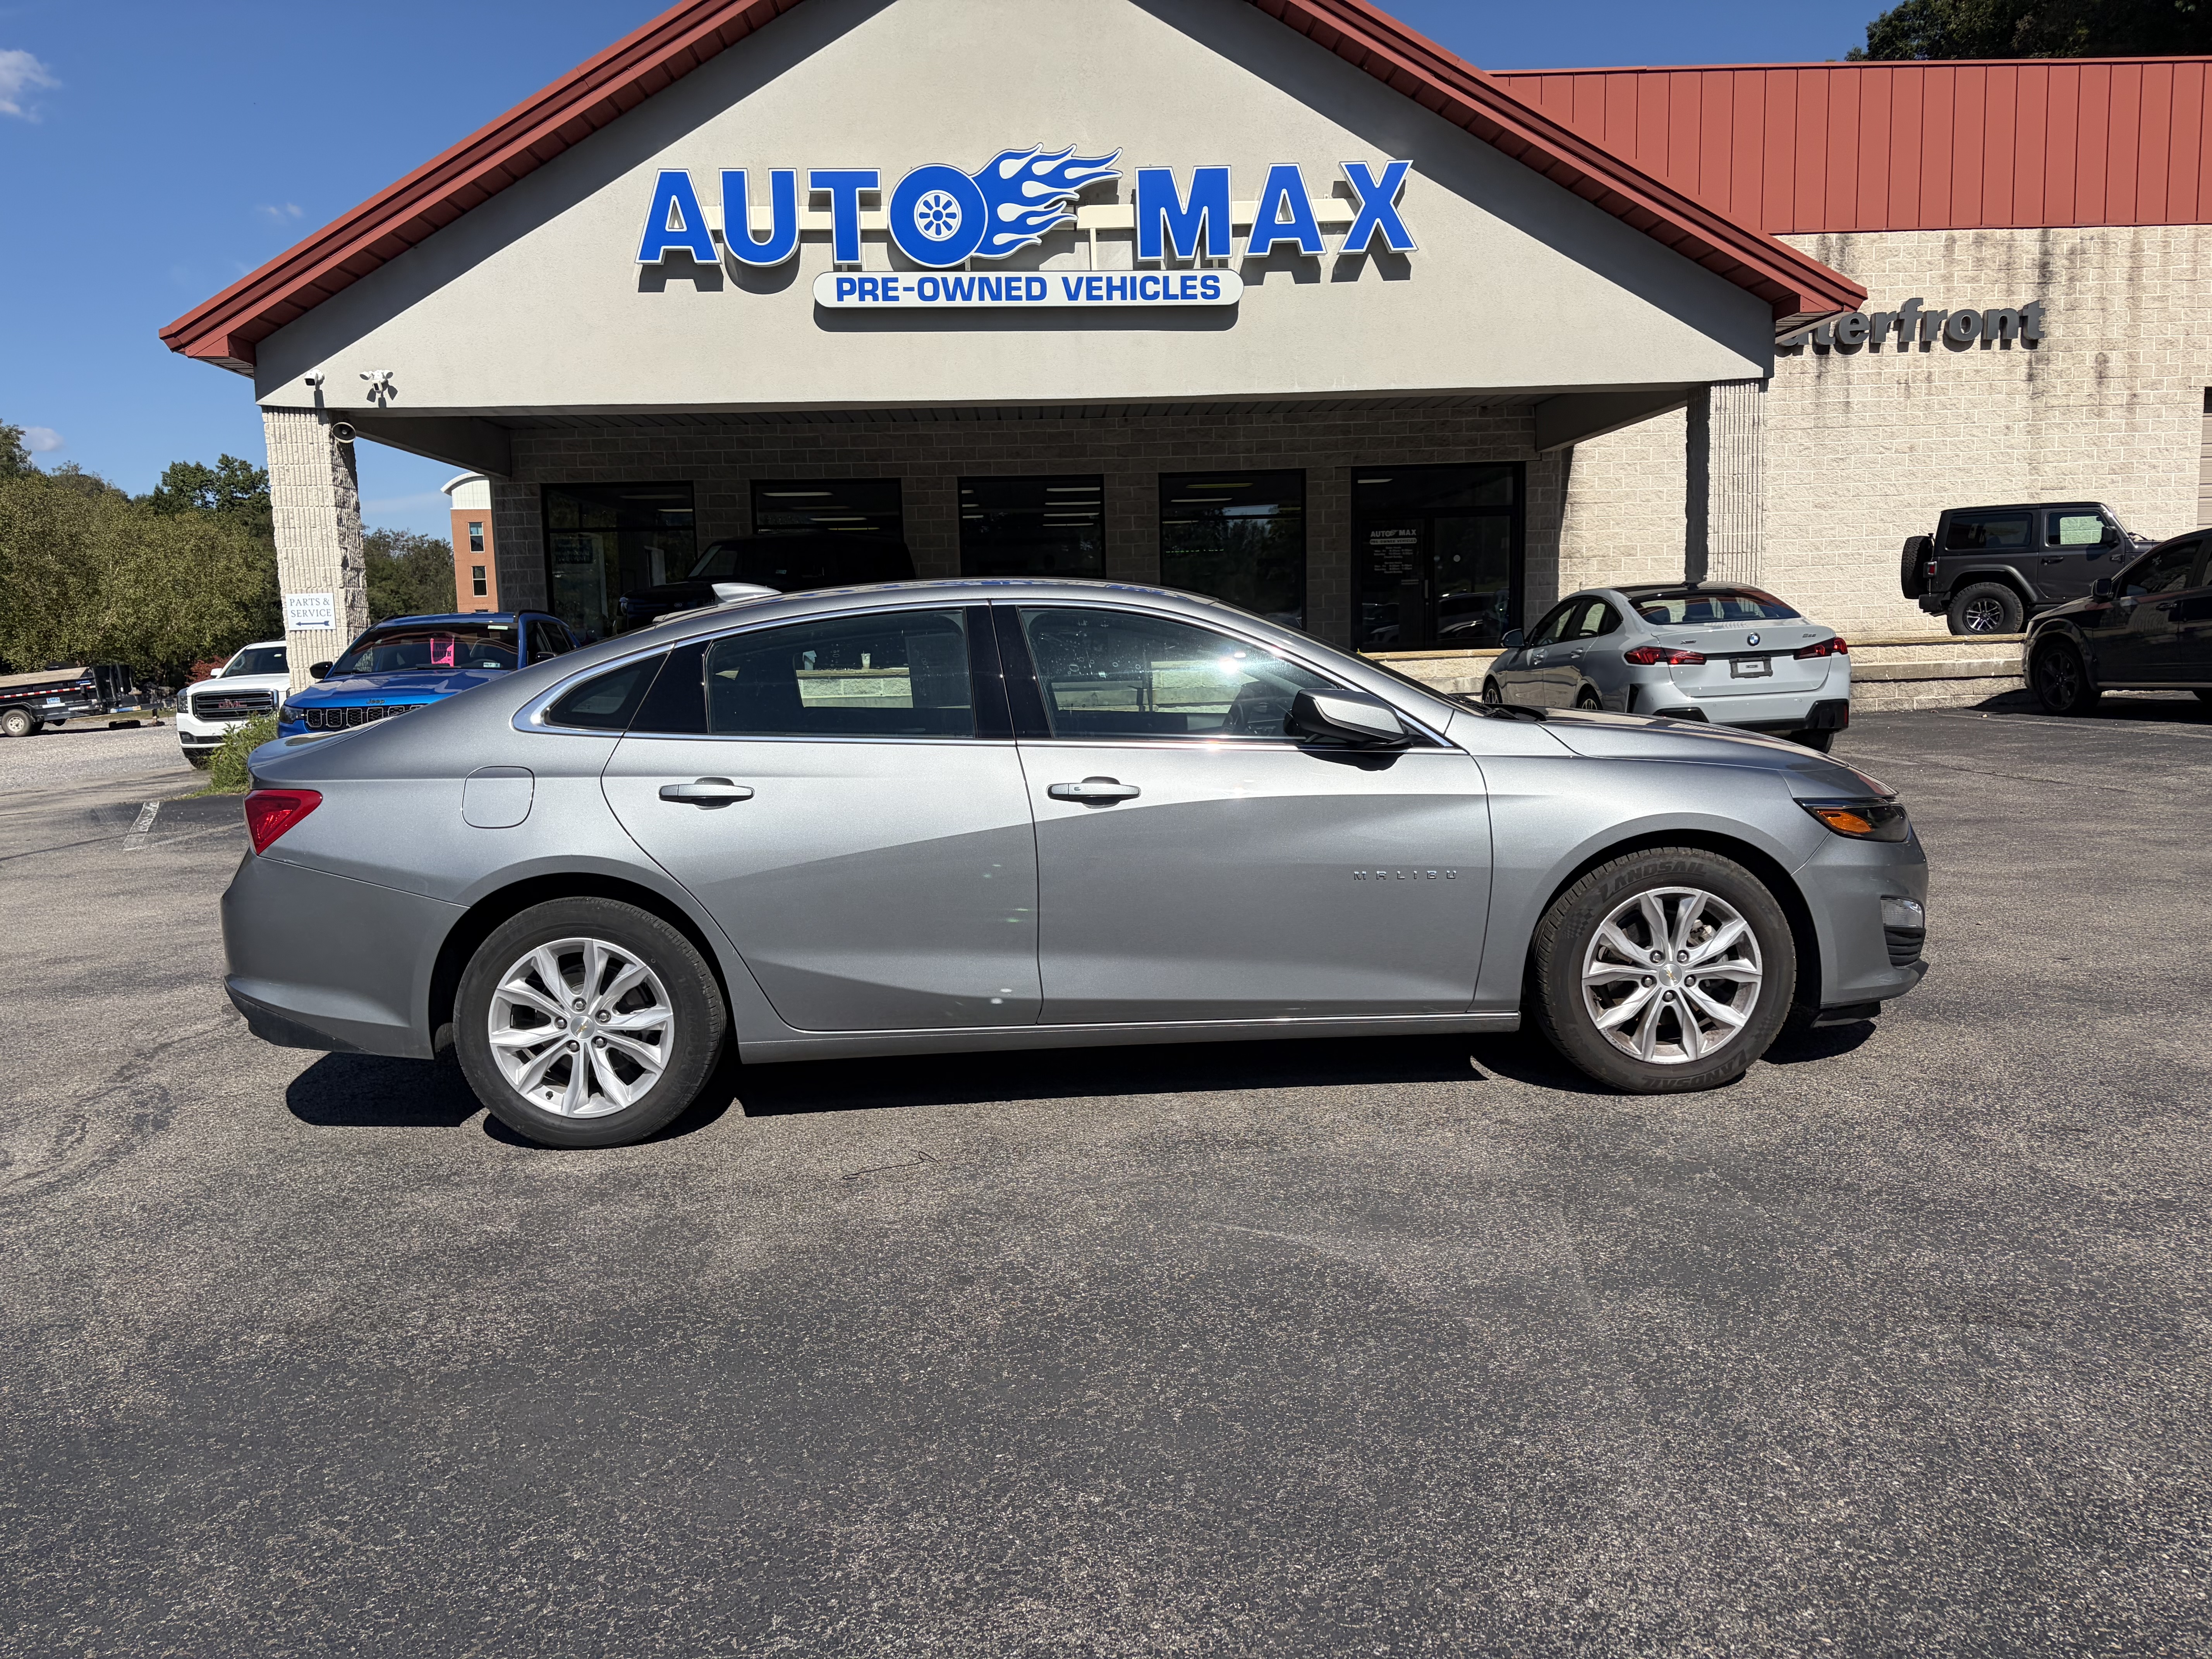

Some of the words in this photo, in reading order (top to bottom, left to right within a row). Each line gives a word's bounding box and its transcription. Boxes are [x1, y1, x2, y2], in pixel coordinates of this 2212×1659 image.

[635, 163, 988, 268] AUTO
[1135, 160, 1419, 262] MAX
[836, 276, 1048, 302] PRE-OWNED
[1061, 275, 1221, 300] VEHICLES
[290, 598, 320, 606] PARTS
[291, 609, 331, 617] SERVICE
[218, 699, 247, 709] GMC
[1354, 870, 1456, 880] MALIBU
[1599, 860, 1706, 903] LANDSAIL
[1642, 1049, 1747, 1089] LANDSAIL
